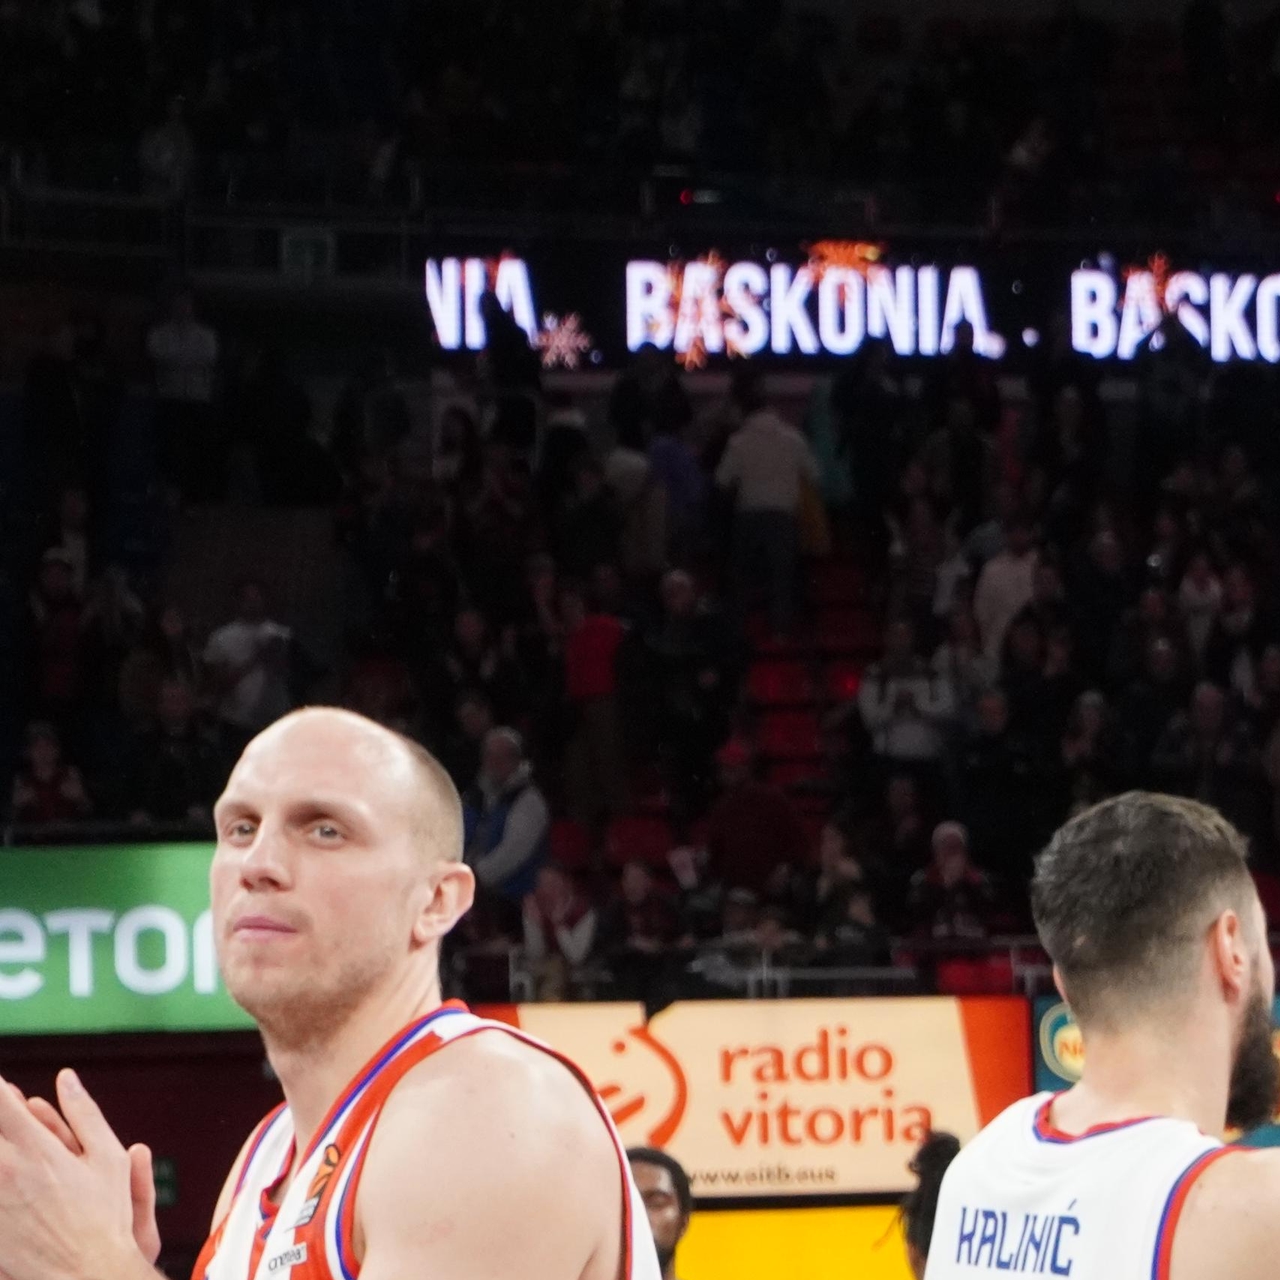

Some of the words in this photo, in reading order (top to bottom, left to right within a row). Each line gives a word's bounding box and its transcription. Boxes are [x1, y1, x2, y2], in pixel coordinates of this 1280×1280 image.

[626, 259, 989, 356] BASKONIA
[721, 1028, 893, 1083] radio
[721, 1088, 932, 1145] vitoria
[955, 1198, 1081, 1277] KALINIĆ
